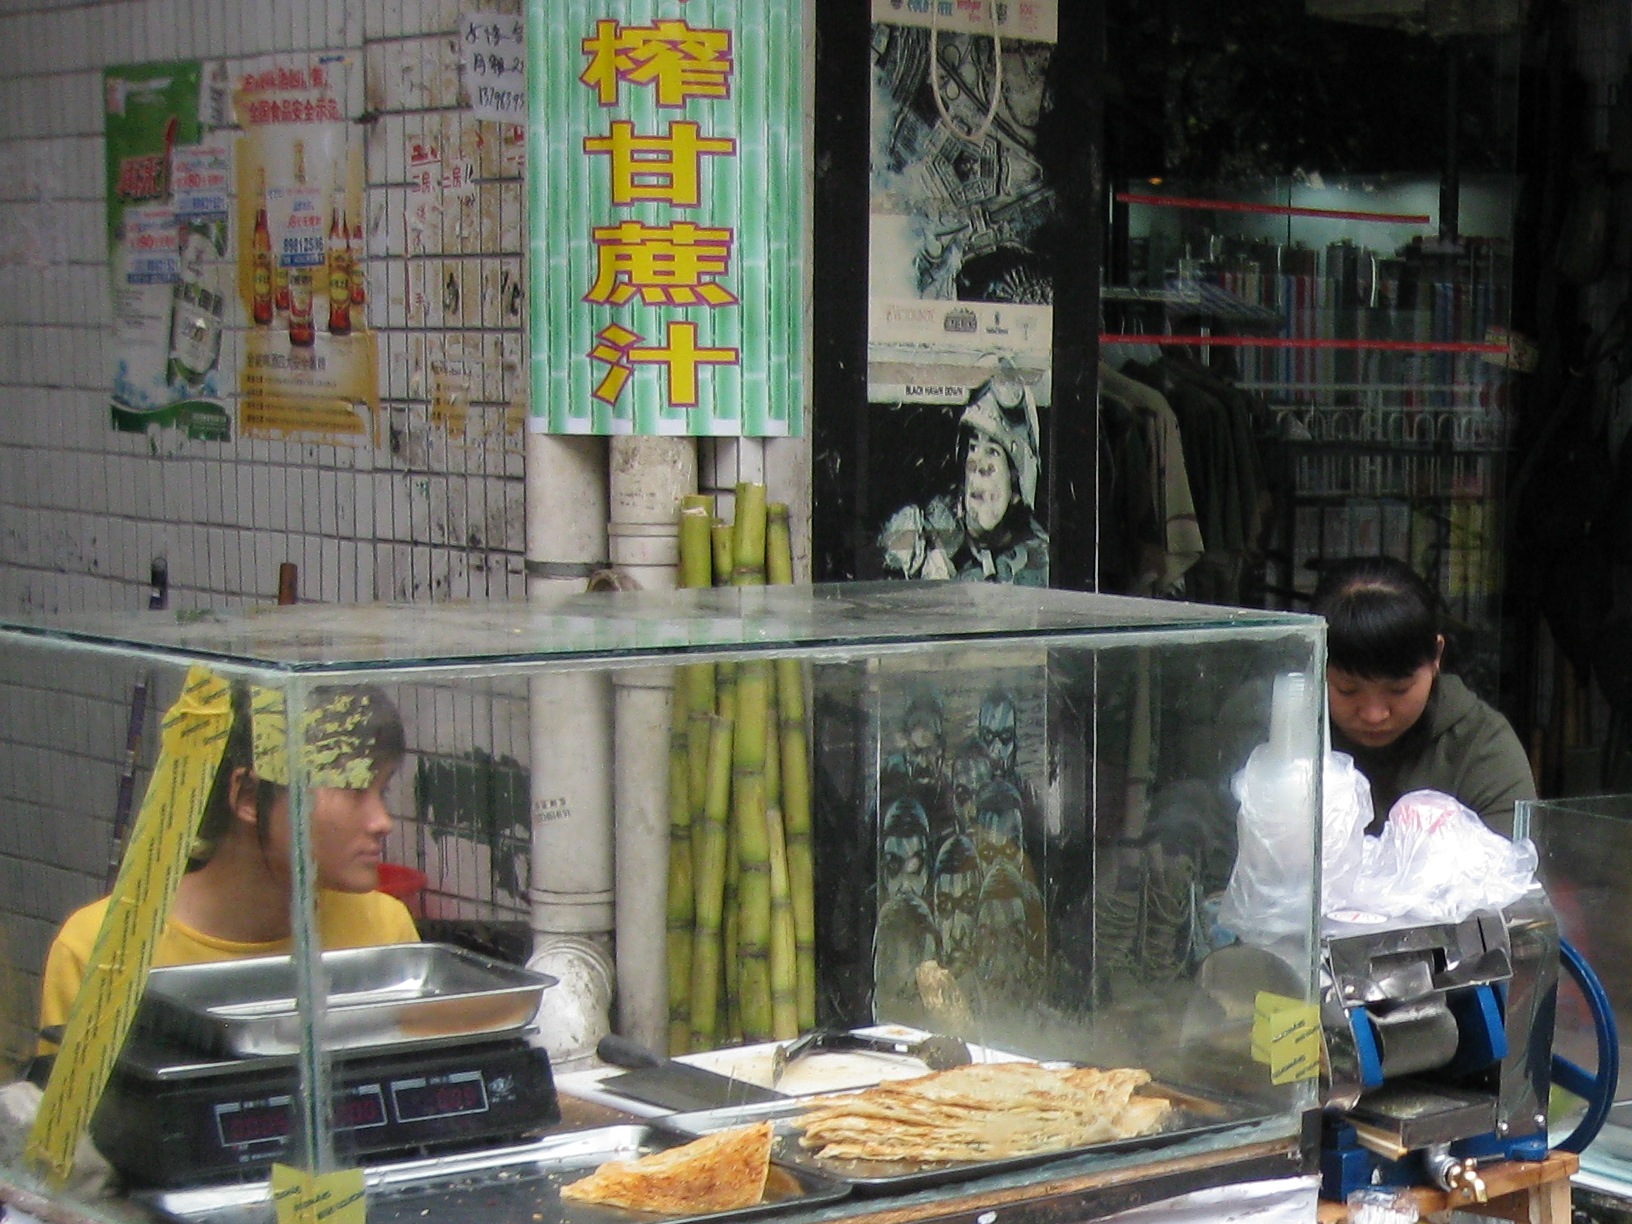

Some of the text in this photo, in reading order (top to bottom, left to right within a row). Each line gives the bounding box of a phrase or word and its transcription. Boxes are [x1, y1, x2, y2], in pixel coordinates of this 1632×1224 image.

[582, 19, 740, 408] 榨甘蔗汁
[905, 385, 924, 395] BLACK
[944, 386, 964, 396] DOWN
